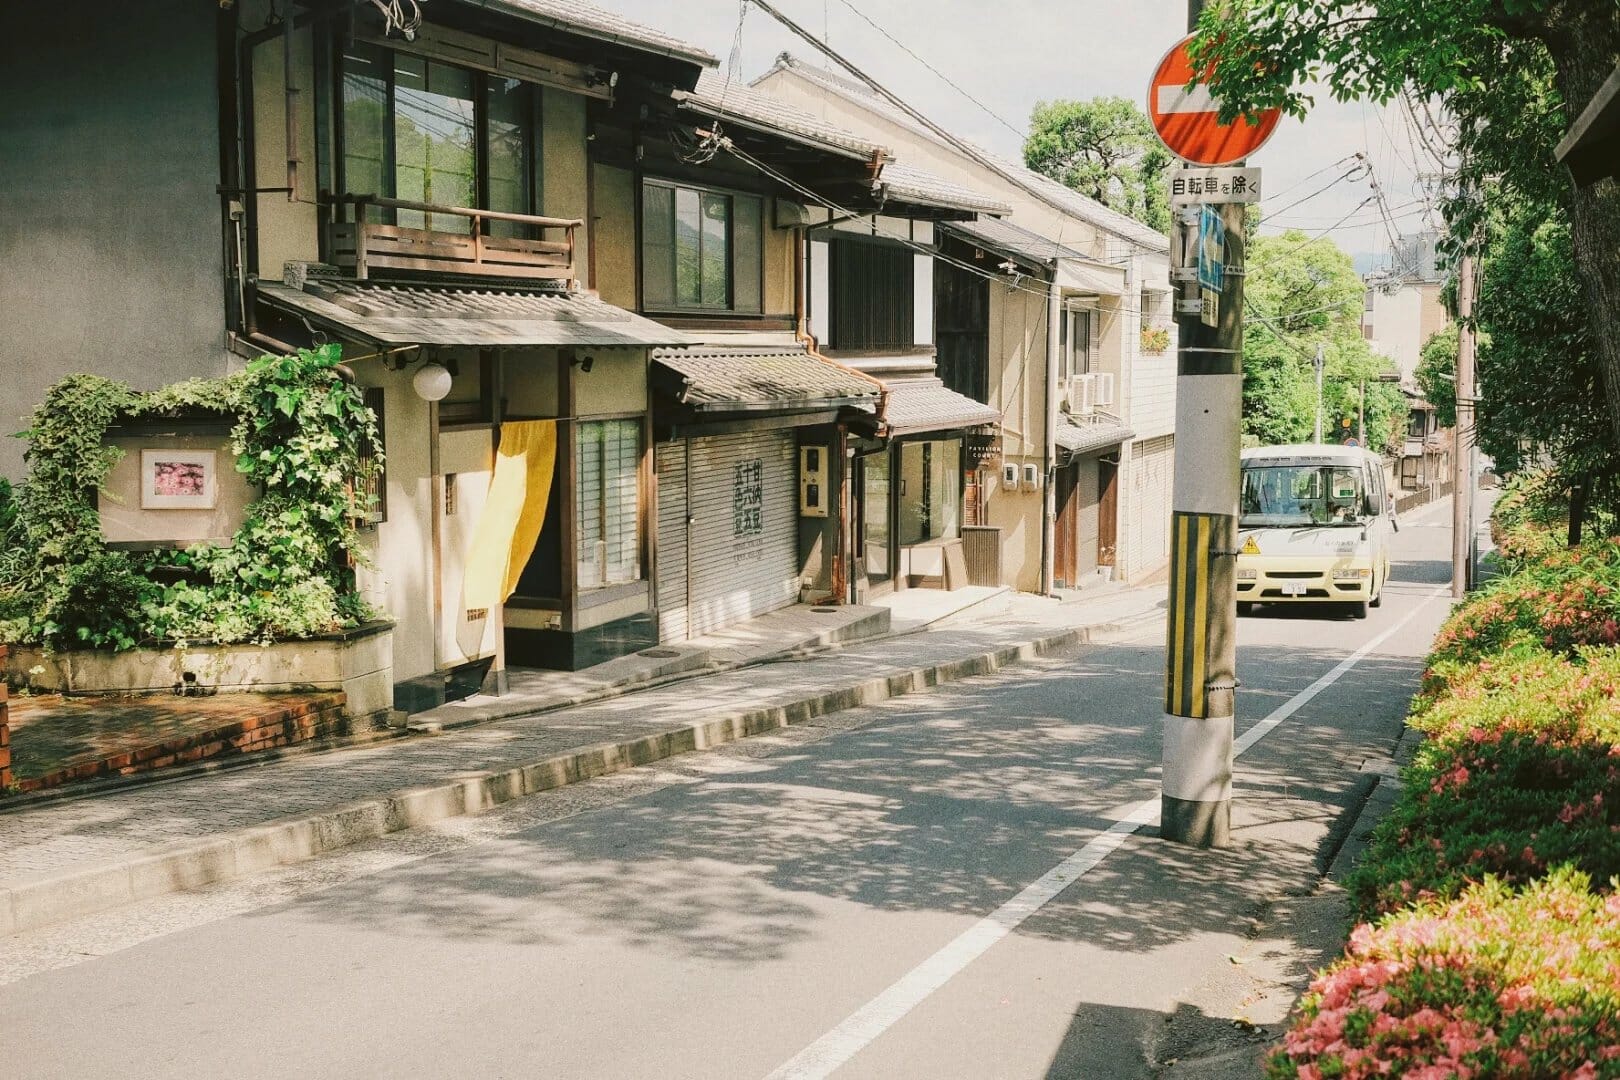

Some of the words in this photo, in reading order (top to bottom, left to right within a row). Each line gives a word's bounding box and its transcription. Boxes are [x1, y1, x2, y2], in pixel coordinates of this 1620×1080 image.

[1172, 176, 1257, 195] 自転車を除く
